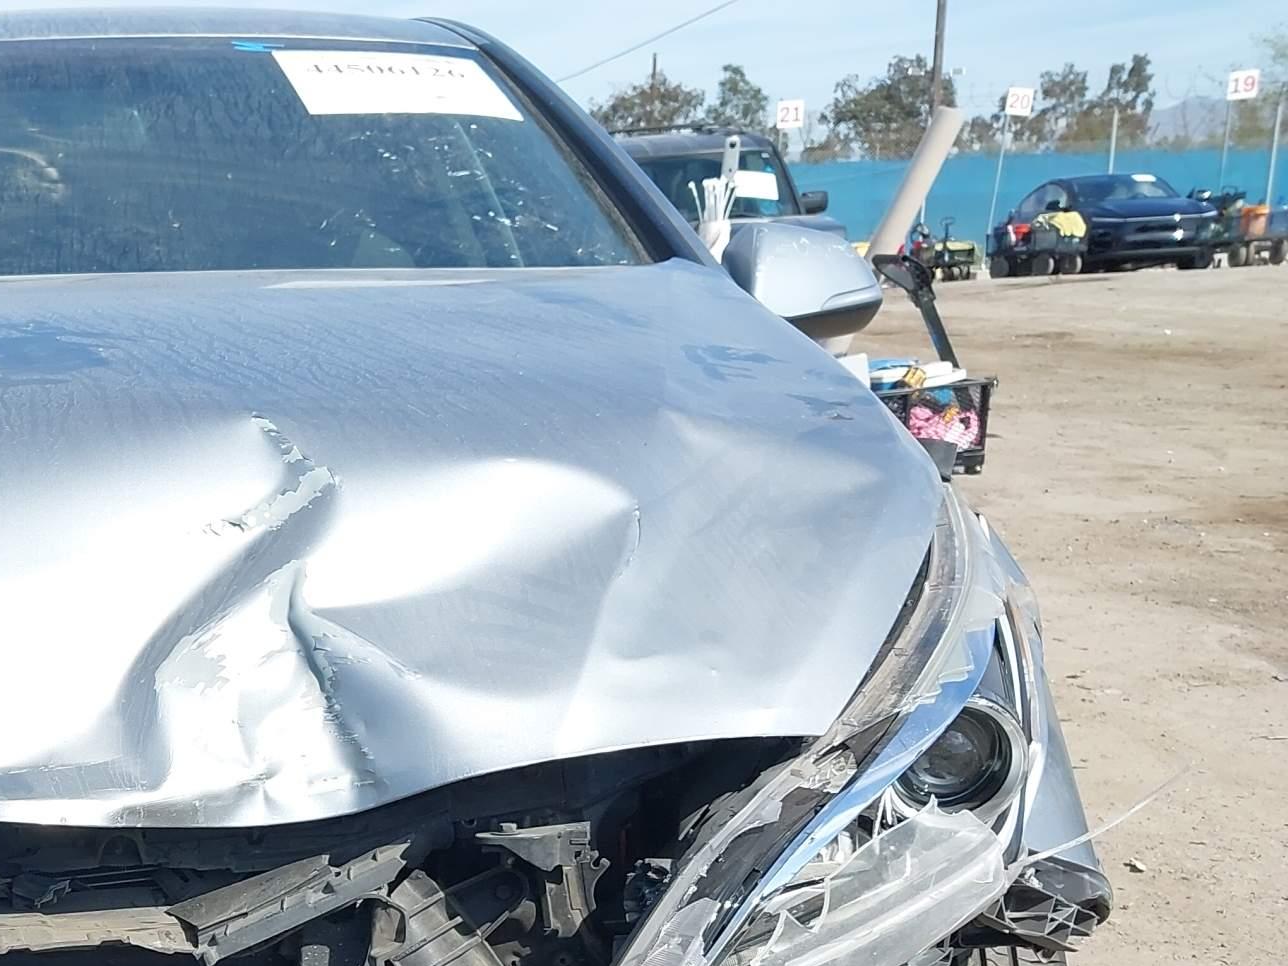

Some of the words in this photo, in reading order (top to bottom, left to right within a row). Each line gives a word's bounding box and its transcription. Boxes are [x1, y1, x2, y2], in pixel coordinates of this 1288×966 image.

[1230, 75, 1256, 94] 19
[1009, 93, 1030, 110] 20
[780, 106, 801, 123] 21
